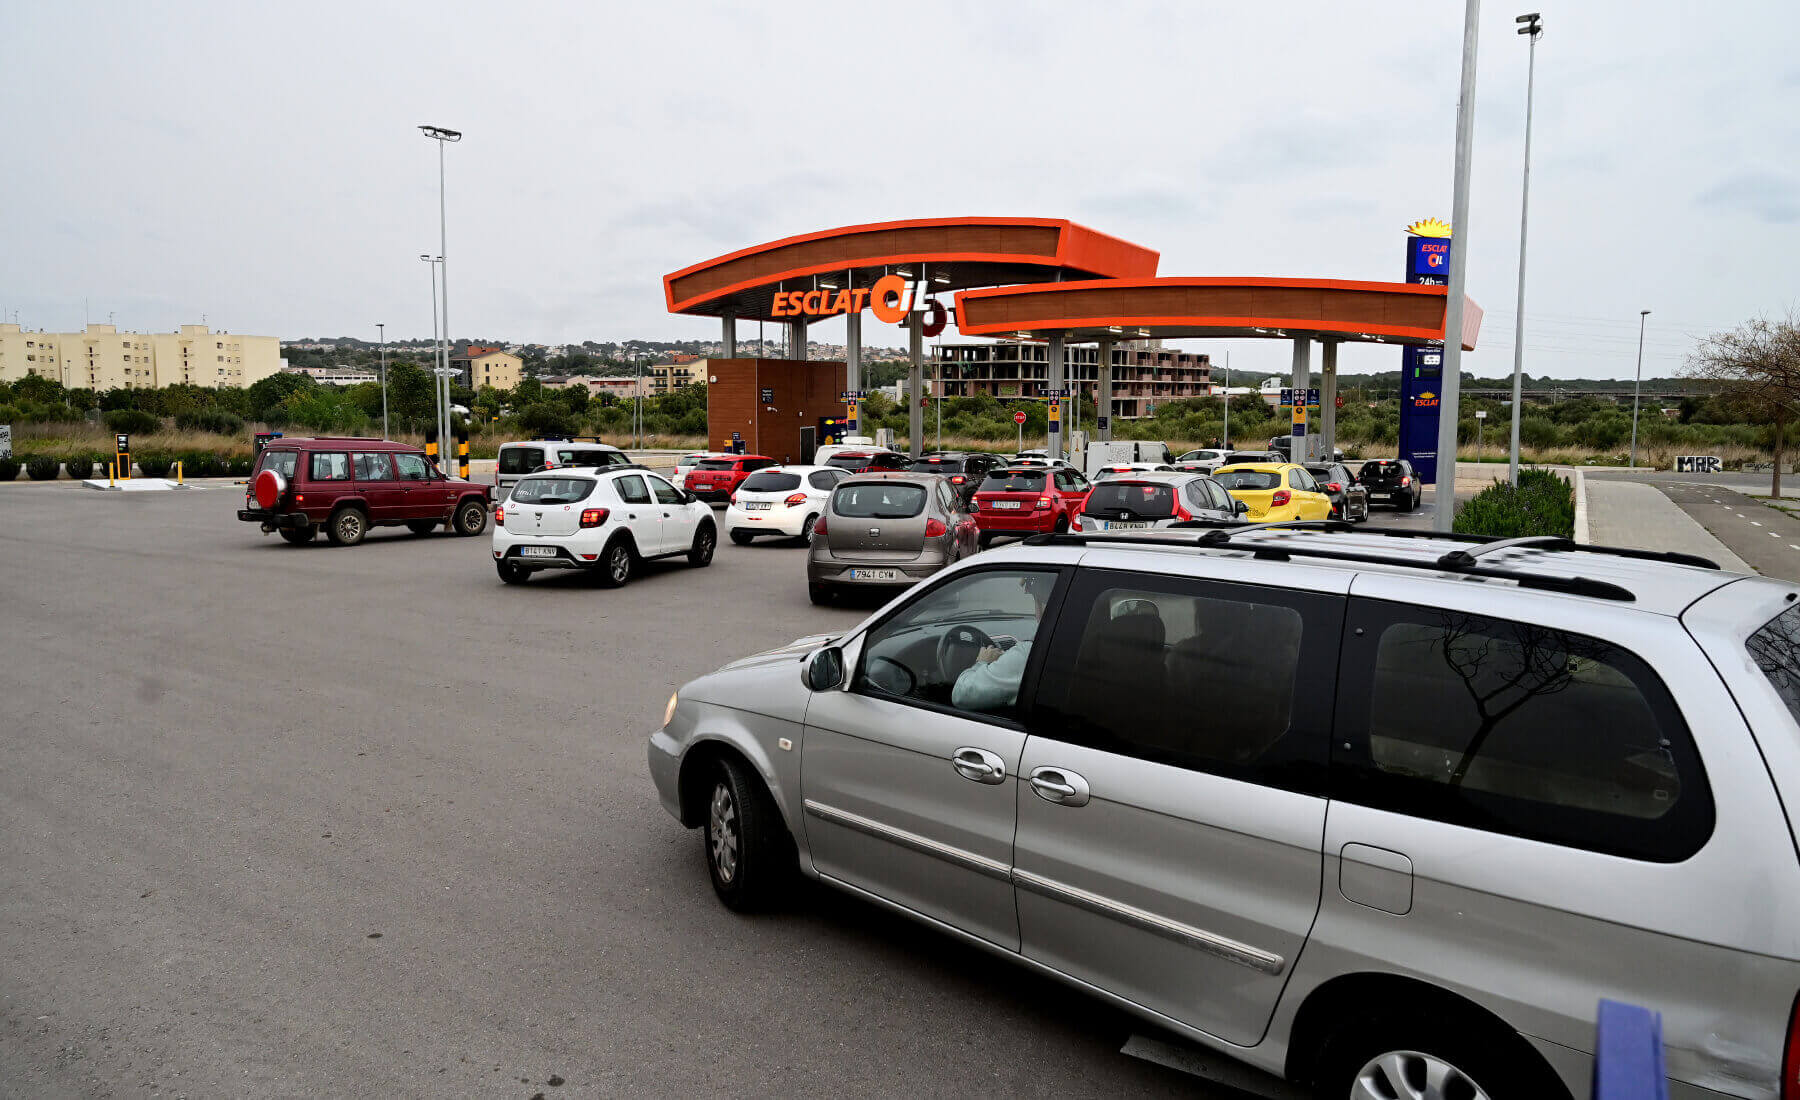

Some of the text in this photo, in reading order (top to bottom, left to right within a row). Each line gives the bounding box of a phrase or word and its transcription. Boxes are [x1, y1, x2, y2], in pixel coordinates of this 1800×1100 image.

[1422, 244, 1448, 253] ESCLAT
[1419, 276, 1435, 286] 24h
[771, 288, 870, 317] ESCLAT
[1415, 399, 1440, 407] ESCLAT
[525, 547, 541, 555] 8141
[856, 570, 875, 578] 7941
